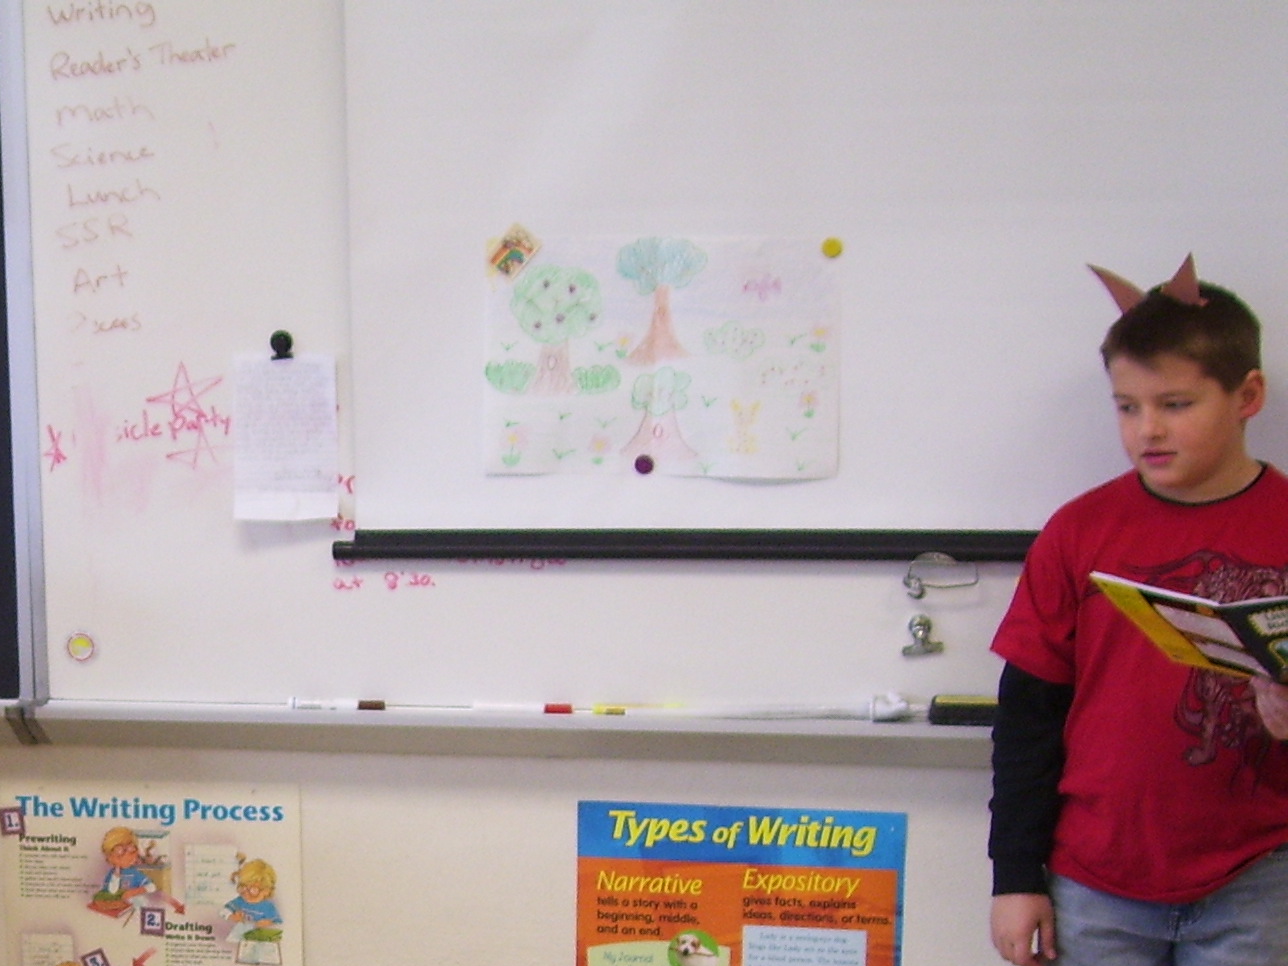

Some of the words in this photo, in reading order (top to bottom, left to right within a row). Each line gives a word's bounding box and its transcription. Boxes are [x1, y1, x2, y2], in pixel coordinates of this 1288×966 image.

[46, 0, 156, 28] Writing
[50, 47, 141, 80] Reader's
[50, 142, 155, 168] Science
[67, 178, 161, 208] Lunch
[73, 264, 129, 294] Art
[15, 796, 64, 818] The
[69, 797, 176, 825] Writing
[183, 799, 285, 822] Process
[19, 833, 77, 847] Prewriting
[608, 809, 707, 848] Types
[712, 821, 744, 849] of
[748, 815, 877, 857] Writing
[596, 870, 703, 895] Narrative
[742, 868, 861, 899] Expository
[632, 898, 660, 910] story
[165, 921, 213, 935] Drafting
[597, 924, 618, 934] and
[621, 926, 636, 935] an
[841, 915, 852, 924] or
